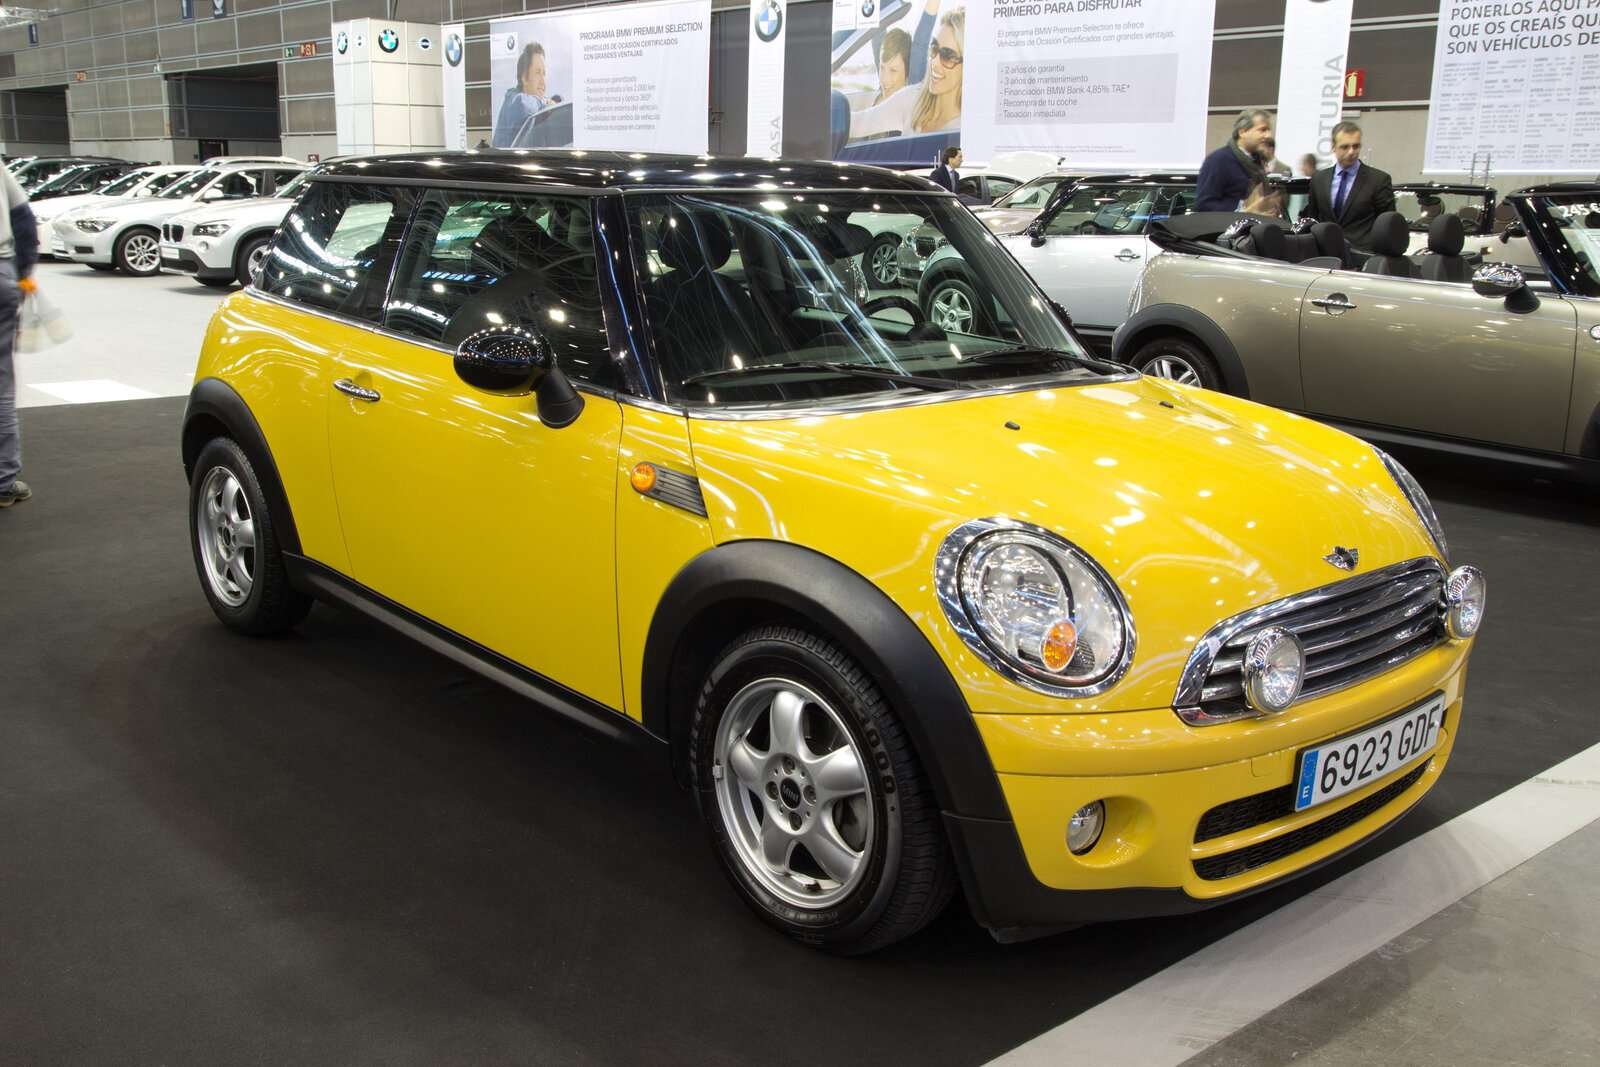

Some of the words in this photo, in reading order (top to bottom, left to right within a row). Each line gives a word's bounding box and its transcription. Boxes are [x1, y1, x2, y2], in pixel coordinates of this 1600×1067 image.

[993, 4, 1041, 18] PRIMERO
[1044, 2, 1074, 15] PARA
[1077, 0, 1142, 12] DISFRUTAR
[1451, 1, 1533, 21] PONERLOS
[579, 29, 615, 41] PROGRAMA
[616, 27, 632, 38] BMW
[633, 24, 664, 36] PREMIUM
[665, 22, 703, 33] SELECTION
[1005, 30, 1033, 39] programa
[1034, 27, 1053, 36] BMW
[1053, 25, 1081, 34] Premium
[1082, 24, 1113, 33] Selection
[1450, 23, 1480, 38] QUE
[1484, 21, 1505, 35] OS
[1510, 13, 1567, 33] CREAÍS
[1572, 13, 1600, 29] QU
[1063, 34, 1101, 44] Certificados
[1117, 32, 1143, 42] grandes
[1447, 40, 1478, 55] SON
[1482, 33, 1573, 52] VEHÍCULOS
[1028, 65, 1037, 73] de
[1027, 76, 1036, 85] de
[1037, 75, 1088, 84] mantenimiento
[1046, 85, 1066, 95] BMW
[1067, 84, 1084, 94] Bank
[1003, 98, 1037, 108] Recompra
[1038, 98, 1047, 106] de
[1057, 97, 1078, 106] coche
[1316, 54, 1345, 160] OTURIA
[1033, 108, 1066, 118] inmediata
[1320, 730, 1393, 793] 6923
[1398, 703, 1441, 761] GDF
[1302, 785, 1310, 799] E
